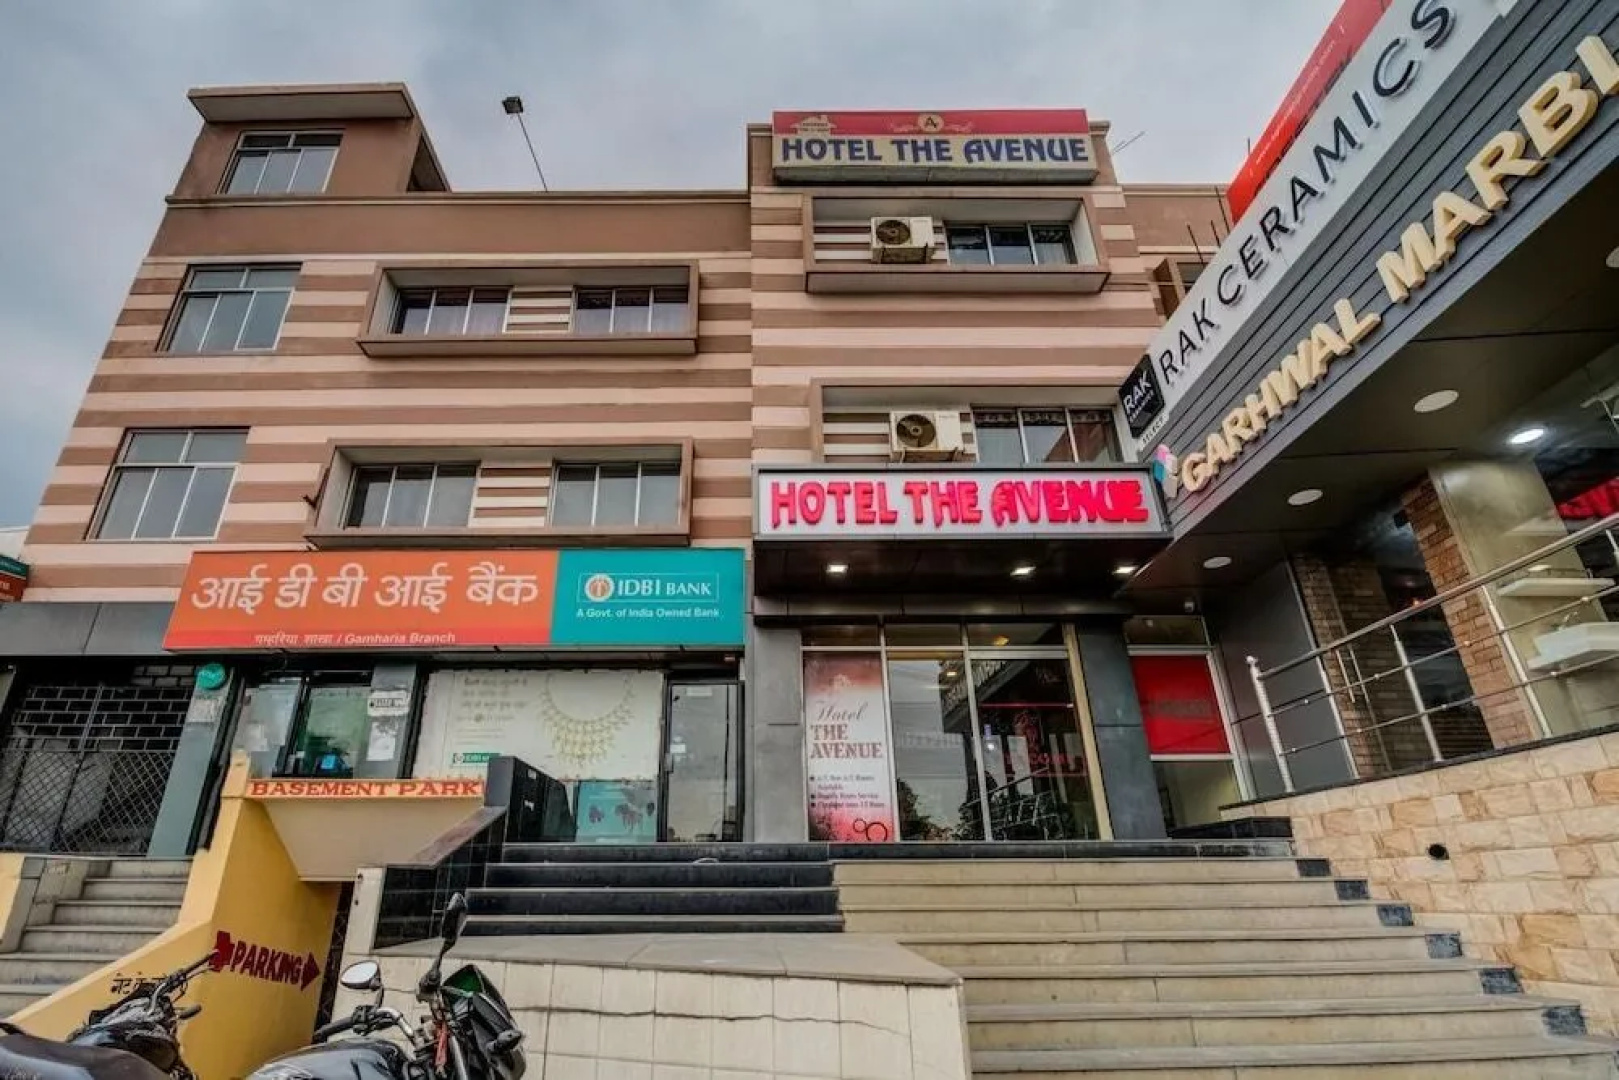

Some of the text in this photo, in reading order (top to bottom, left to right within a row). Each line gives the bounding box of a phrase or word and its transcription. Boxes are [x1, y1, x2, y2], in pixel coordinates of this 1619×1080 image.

[782, 138, 1089, 164] HOTEL THE AVENUE
[1158, 297, 1217, 385] RAK
[1217, 0, 1453, 306] CERAMICS
[1123, 370, 1152, 415] RAK
[1181, 298, 1382, 492] GARHWAL
[771, 479, 1149, 528] HOTEL THE AVENUE
[191, 561, 539, 614] आई डी बी आई बैंक
[617, 578, 712, 597] IDBI BANK
[576, 607, 720, 618] A Govt. of India Owned Bank
[345, 632, 406, 645] Gamharia
[409, 632, 455, 645] Branch
[810, 724, 848, 741] THE
[810, 742, 883, 759] AVENUE
[251, 780, 479, 796] BASEMENT PARK
[230, 940, 303, 985] PARKING
